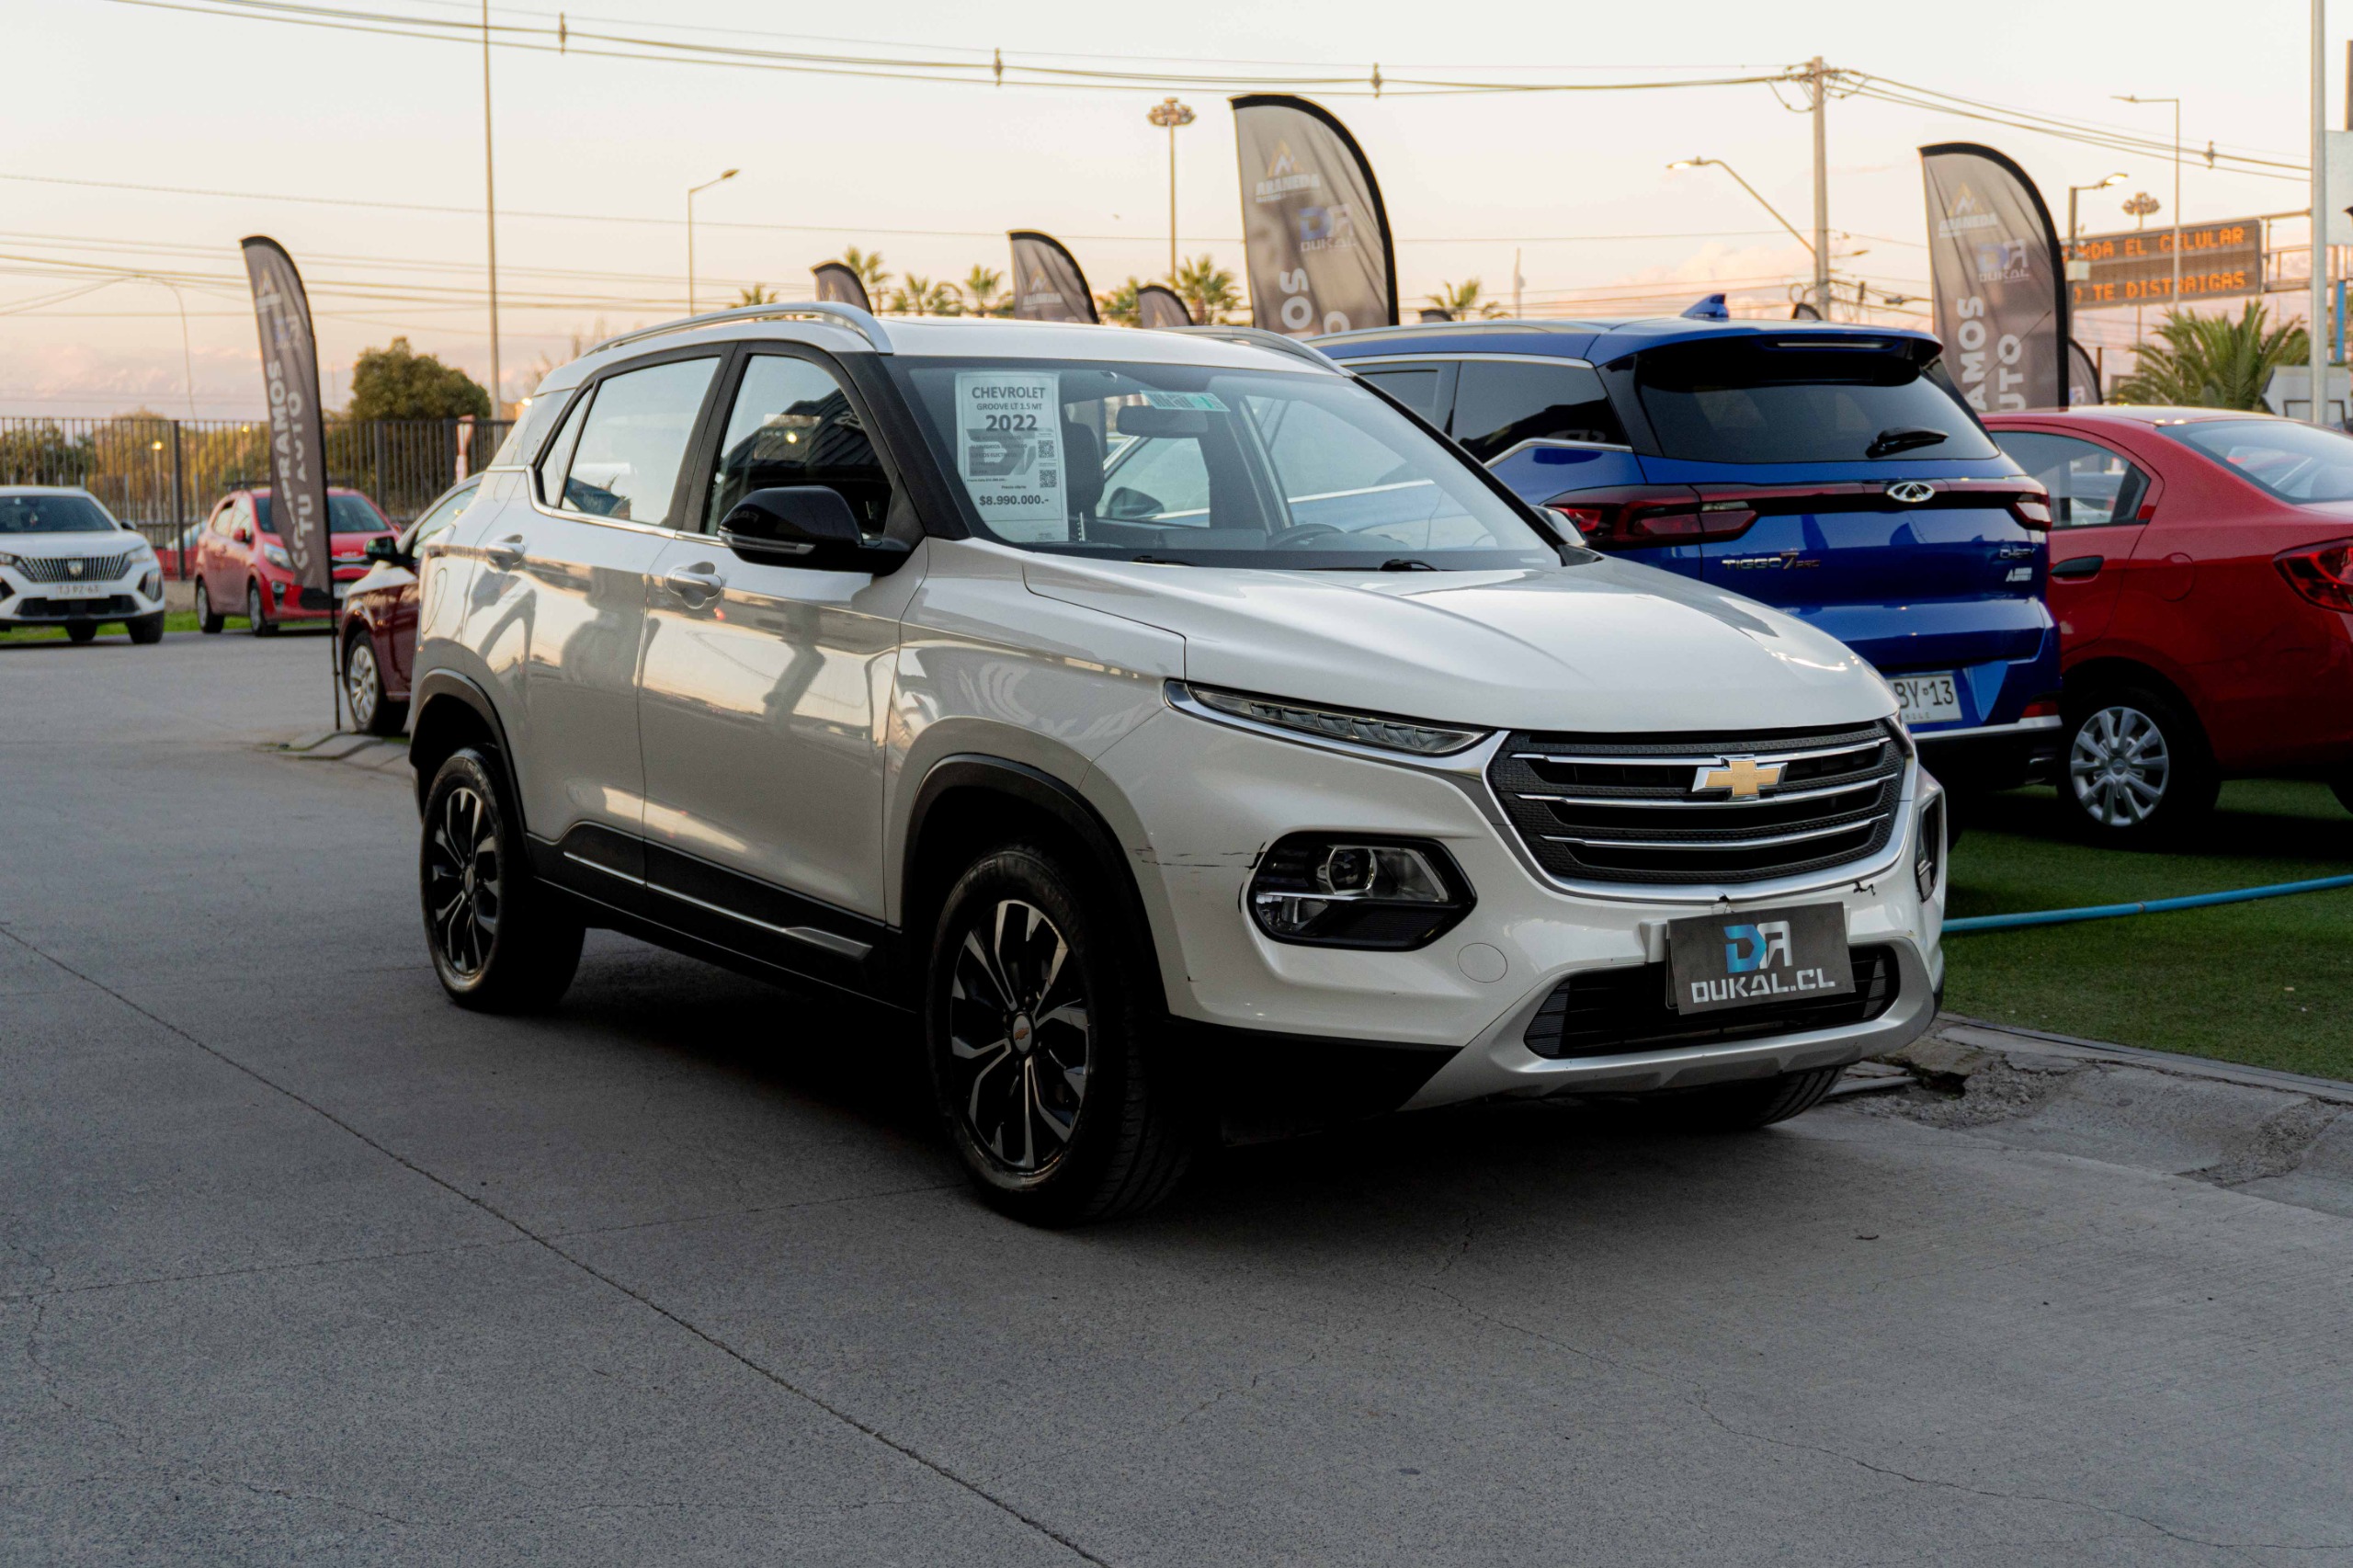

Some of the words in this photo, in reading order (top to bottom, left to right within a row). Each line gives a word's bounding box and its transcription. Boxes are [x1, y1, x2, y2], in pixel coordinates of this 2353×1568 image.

[2125, 238, 2147, 256] EL
[2092, 283, 2115, 301] TE
[972, 386, 1046, 399] CHEVROLET
[976, 403, 1008, 411] GROOVE
[985, 414, 1038, 432] 2022
[979, 494, 1050, 506] $8.990.000.-
[298, 494, 314, 538] TU
[1690, 968, 1836, 1004] DUKAL.CL
